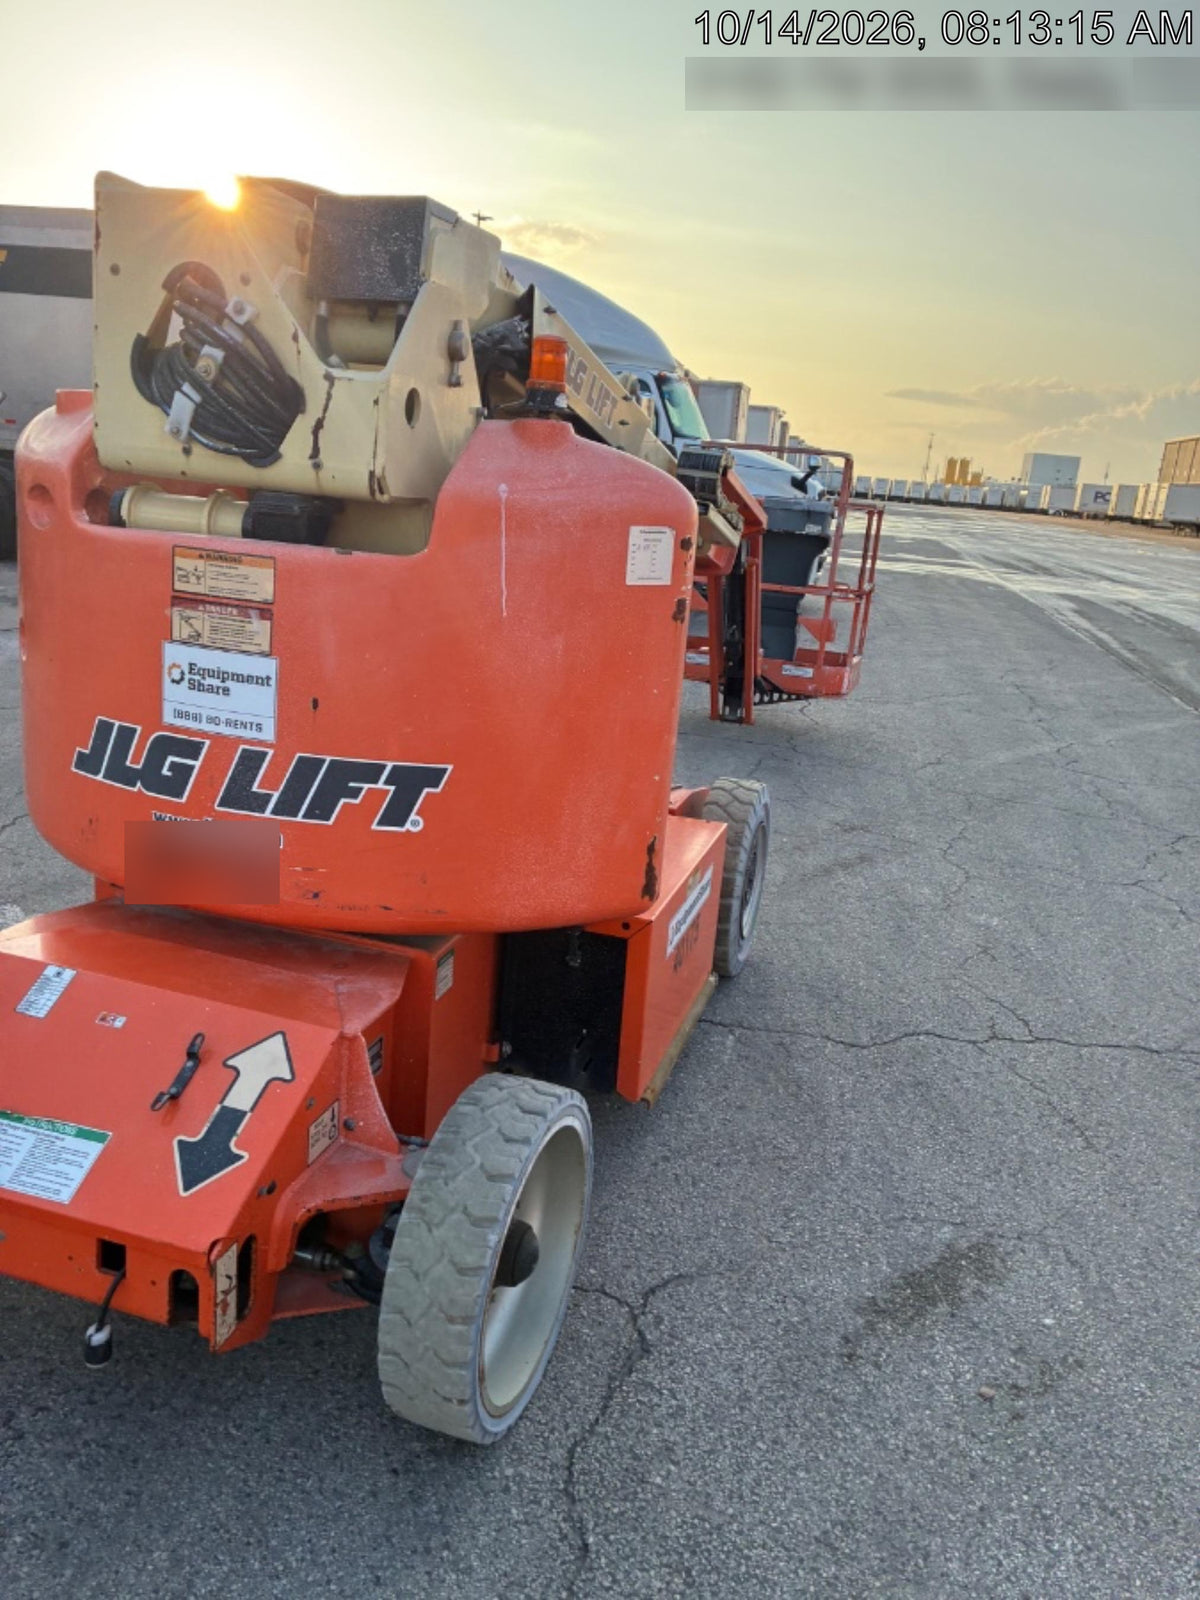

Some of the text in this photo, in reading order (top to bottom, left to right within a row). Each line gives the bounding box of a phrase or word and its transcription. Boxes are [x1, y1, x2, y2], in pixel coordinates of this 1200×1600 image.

[586, 371, 619, 430] LIFT
[187, 678, 231, 697] Share
[188, 662, 272, 687] Equipment
[72, 716, 210, 802] JLG
[215, 745, 453, 831] LIFT
